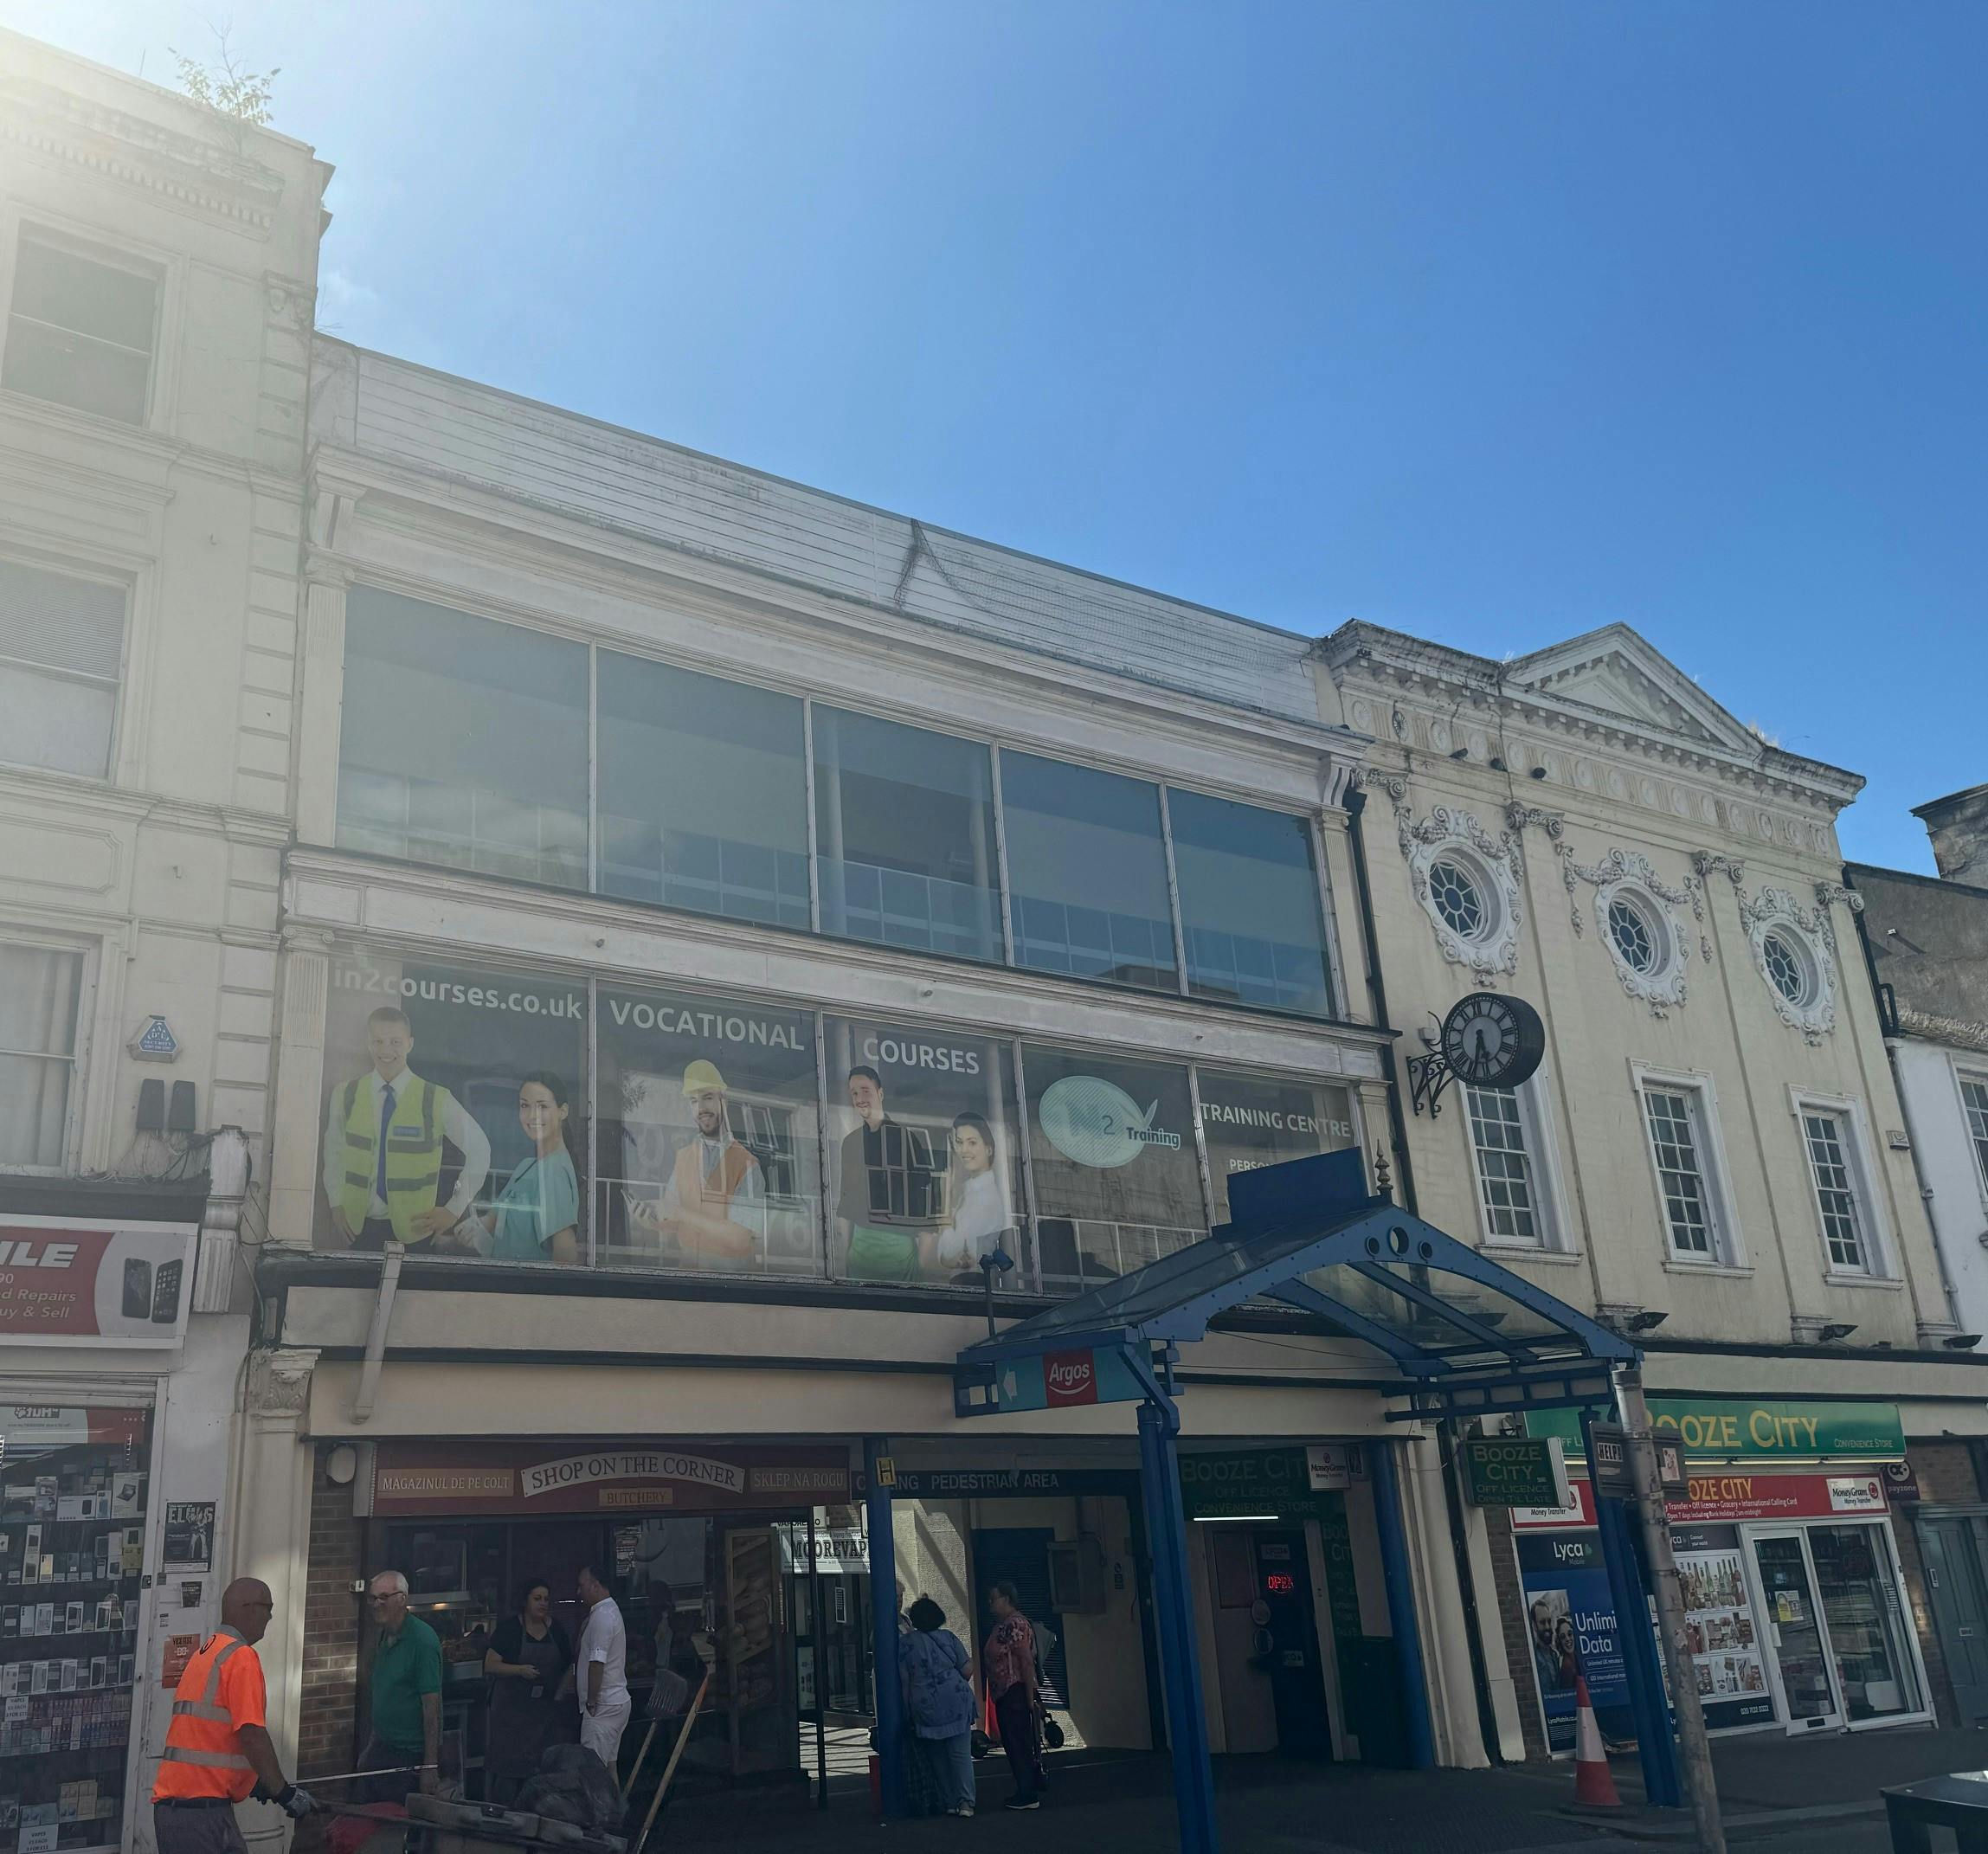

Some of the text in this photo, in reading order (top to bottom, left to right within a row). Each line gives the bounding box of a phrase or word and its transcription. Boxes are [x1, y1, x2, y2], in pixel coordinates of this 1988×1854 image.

[332, 962, 582, 1020] in2courses.co.uk
[609, 1000, 805, 1051] VOCATIONAL
[864, 1038, 980, 1075] COURSES
[1200, 1102, 1351, 1137] TRAINING CENTRE
[1126, 1127, 1180, 1149] Training
[17, 1289, 76, 1304] Repairs
[23, 1306, 35, 1317] &
[41, 1307, 70, 1318] Sell
[1048, 1362, 1091, 1387] Argos
[1646, 1408, 1818, 1448] OZE CITY
[1560, 1438, 1572, 1446] FF
[1835, 1439, 1894, 1448] CONVENIENCE STORE
[1473, 1445, 1541, 1462] BOOZE
[1599, 1444, 1622, 1460] HELP!
[531, 1457, 736, 1490] SHOP ON THE CORNER
[1181, 1454, 1305, 1482] BOOZE CIT
[1486, 1464, 1533, 1480] CITY
[383, 1477, 510, 1490] MAGAZINUL DE PE COLT
[754, 1472, 844, 1487] SKLEP NA ROGU
[931, 1474, 1018, 1490] PEDESTRIAN
[1024, 1473, 1059, 1488] AREA
[1215, 1484, 1290, 1498] OFF LICENCE
[1476, 1484, 1552, 1494] OFF LICENCE
[1721, 1478, 1752, 1500] CITY
[1888, 1485, 1917, 1494] payzone
[608, 1491, 666, 1504] BUTCHERY
[1721, 1500, 1738, 1509] Grocery
[1741, 1498, 1771, 1507] International
[1194, 1501, 1317, 1514] CONVENIENCE STORE
[1554, 1542, 1584, 1561] Lyca
[1268, 1575, 1294, 1589] OPEN
[1575, 1611, 1617, 1632] Unlimi
[1579, 1636, 1612, 1654] Data
